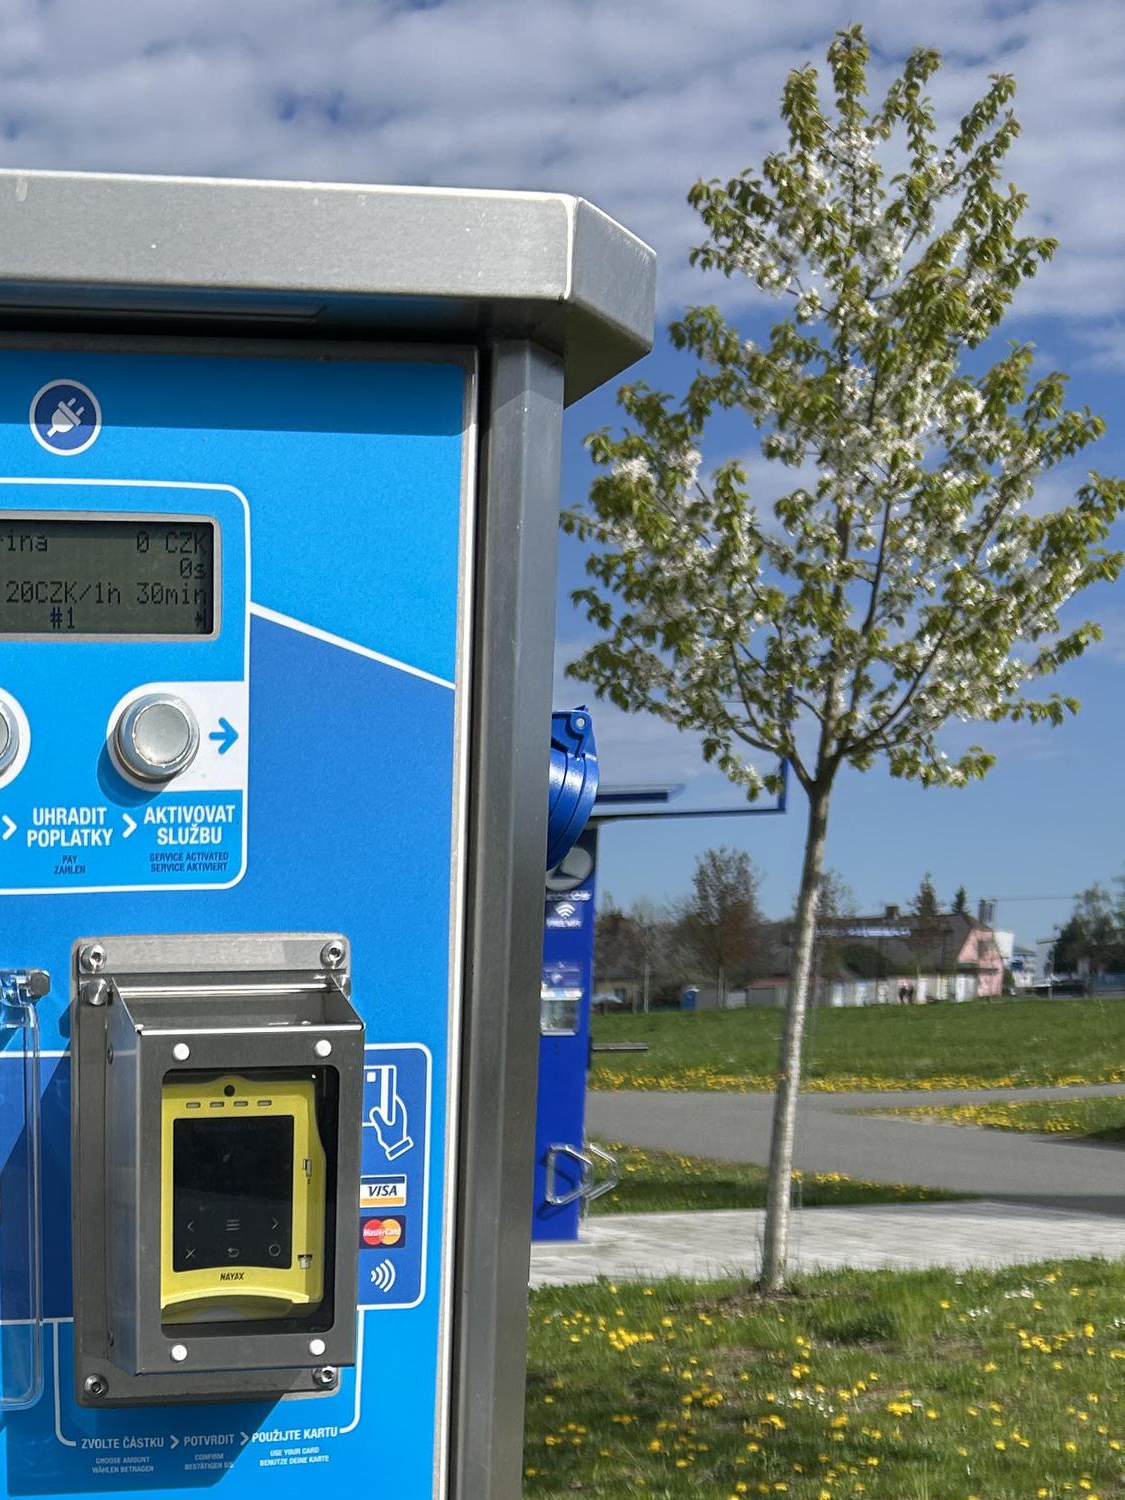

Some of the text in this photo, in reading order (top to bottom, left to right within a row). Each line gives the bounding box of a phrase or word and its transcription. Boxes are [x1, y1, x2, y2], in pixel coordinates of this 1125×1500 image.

[137, 532, 149, 554] 0
[165, 532, 205, 554] CZK
[180, 557, 207, 578] 0s
[6, 581, 121, 604] 20CZK/1h
[137, 583, 207, 606] 30min
[50, 608, 75, 630] #1
[33, 807, 107, 826] UHRADIT
[144, 805, 235, 824] AKTIVOVAT
[27, 829, 113, 848] POPLATKY
[157, 823, 222, 845] SLUŽBU
[62, 855, 77, 864] PAY
[150, 852, 228, 863] SERVICE ACTIVATED
[151, 862, 227, 873] SERVICE AKTIVIERT
[368, 1185, 397, 1197] VISA
[363, 1227, 401, 1237] MasterCard
[220, 1272, 245, 1282] NAYAX
[82, 1436, 164, 1449] ZVOLTE ČÁSTKU
[184, 1434, 235, 1446] POTVRDIT
[252, 1427, 338, 1443] POUŽIJTE KARTU
